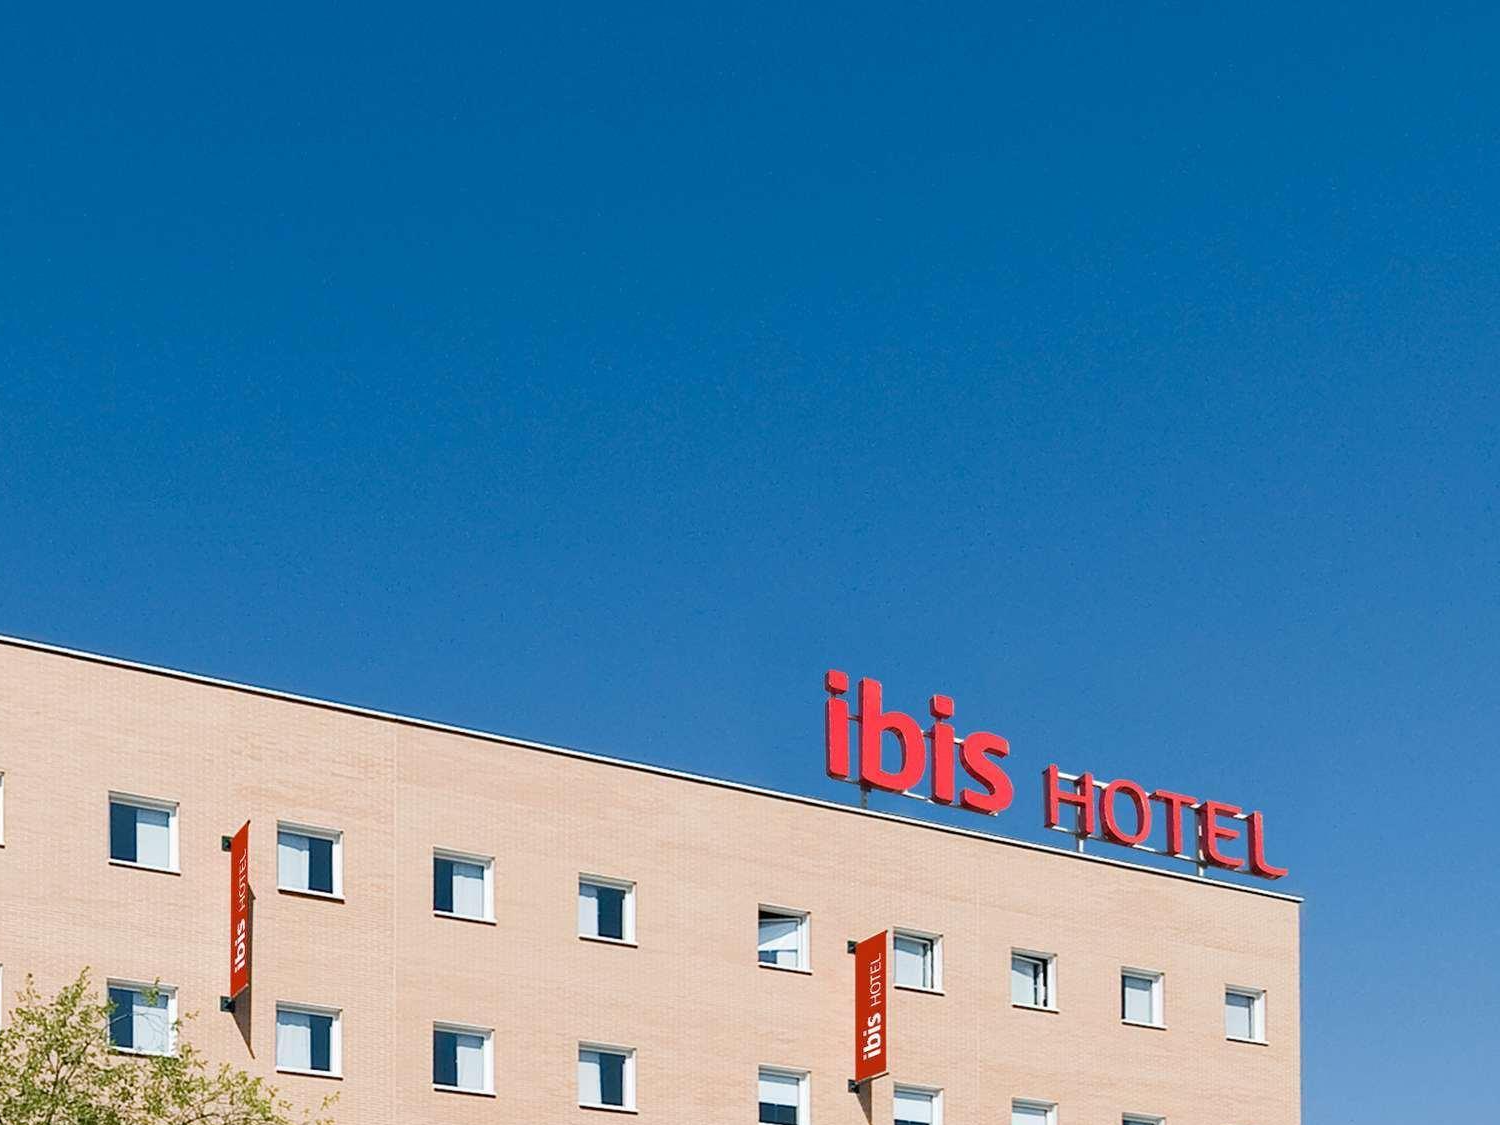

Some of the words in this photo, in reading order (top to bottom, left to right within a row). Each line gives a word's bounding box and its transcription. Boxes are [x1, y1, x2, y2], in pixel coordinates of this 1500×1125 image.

[825, 669, 1014, 816] ibis
[1042, 764, 1288, 880] HOTEL
[238, 848, 247, 912] HOTEL
[234, 918, 246, 973] ibis
[869, 952, 882, 1007] HOTEL
[863, 1012, 882, 1061] ibis
